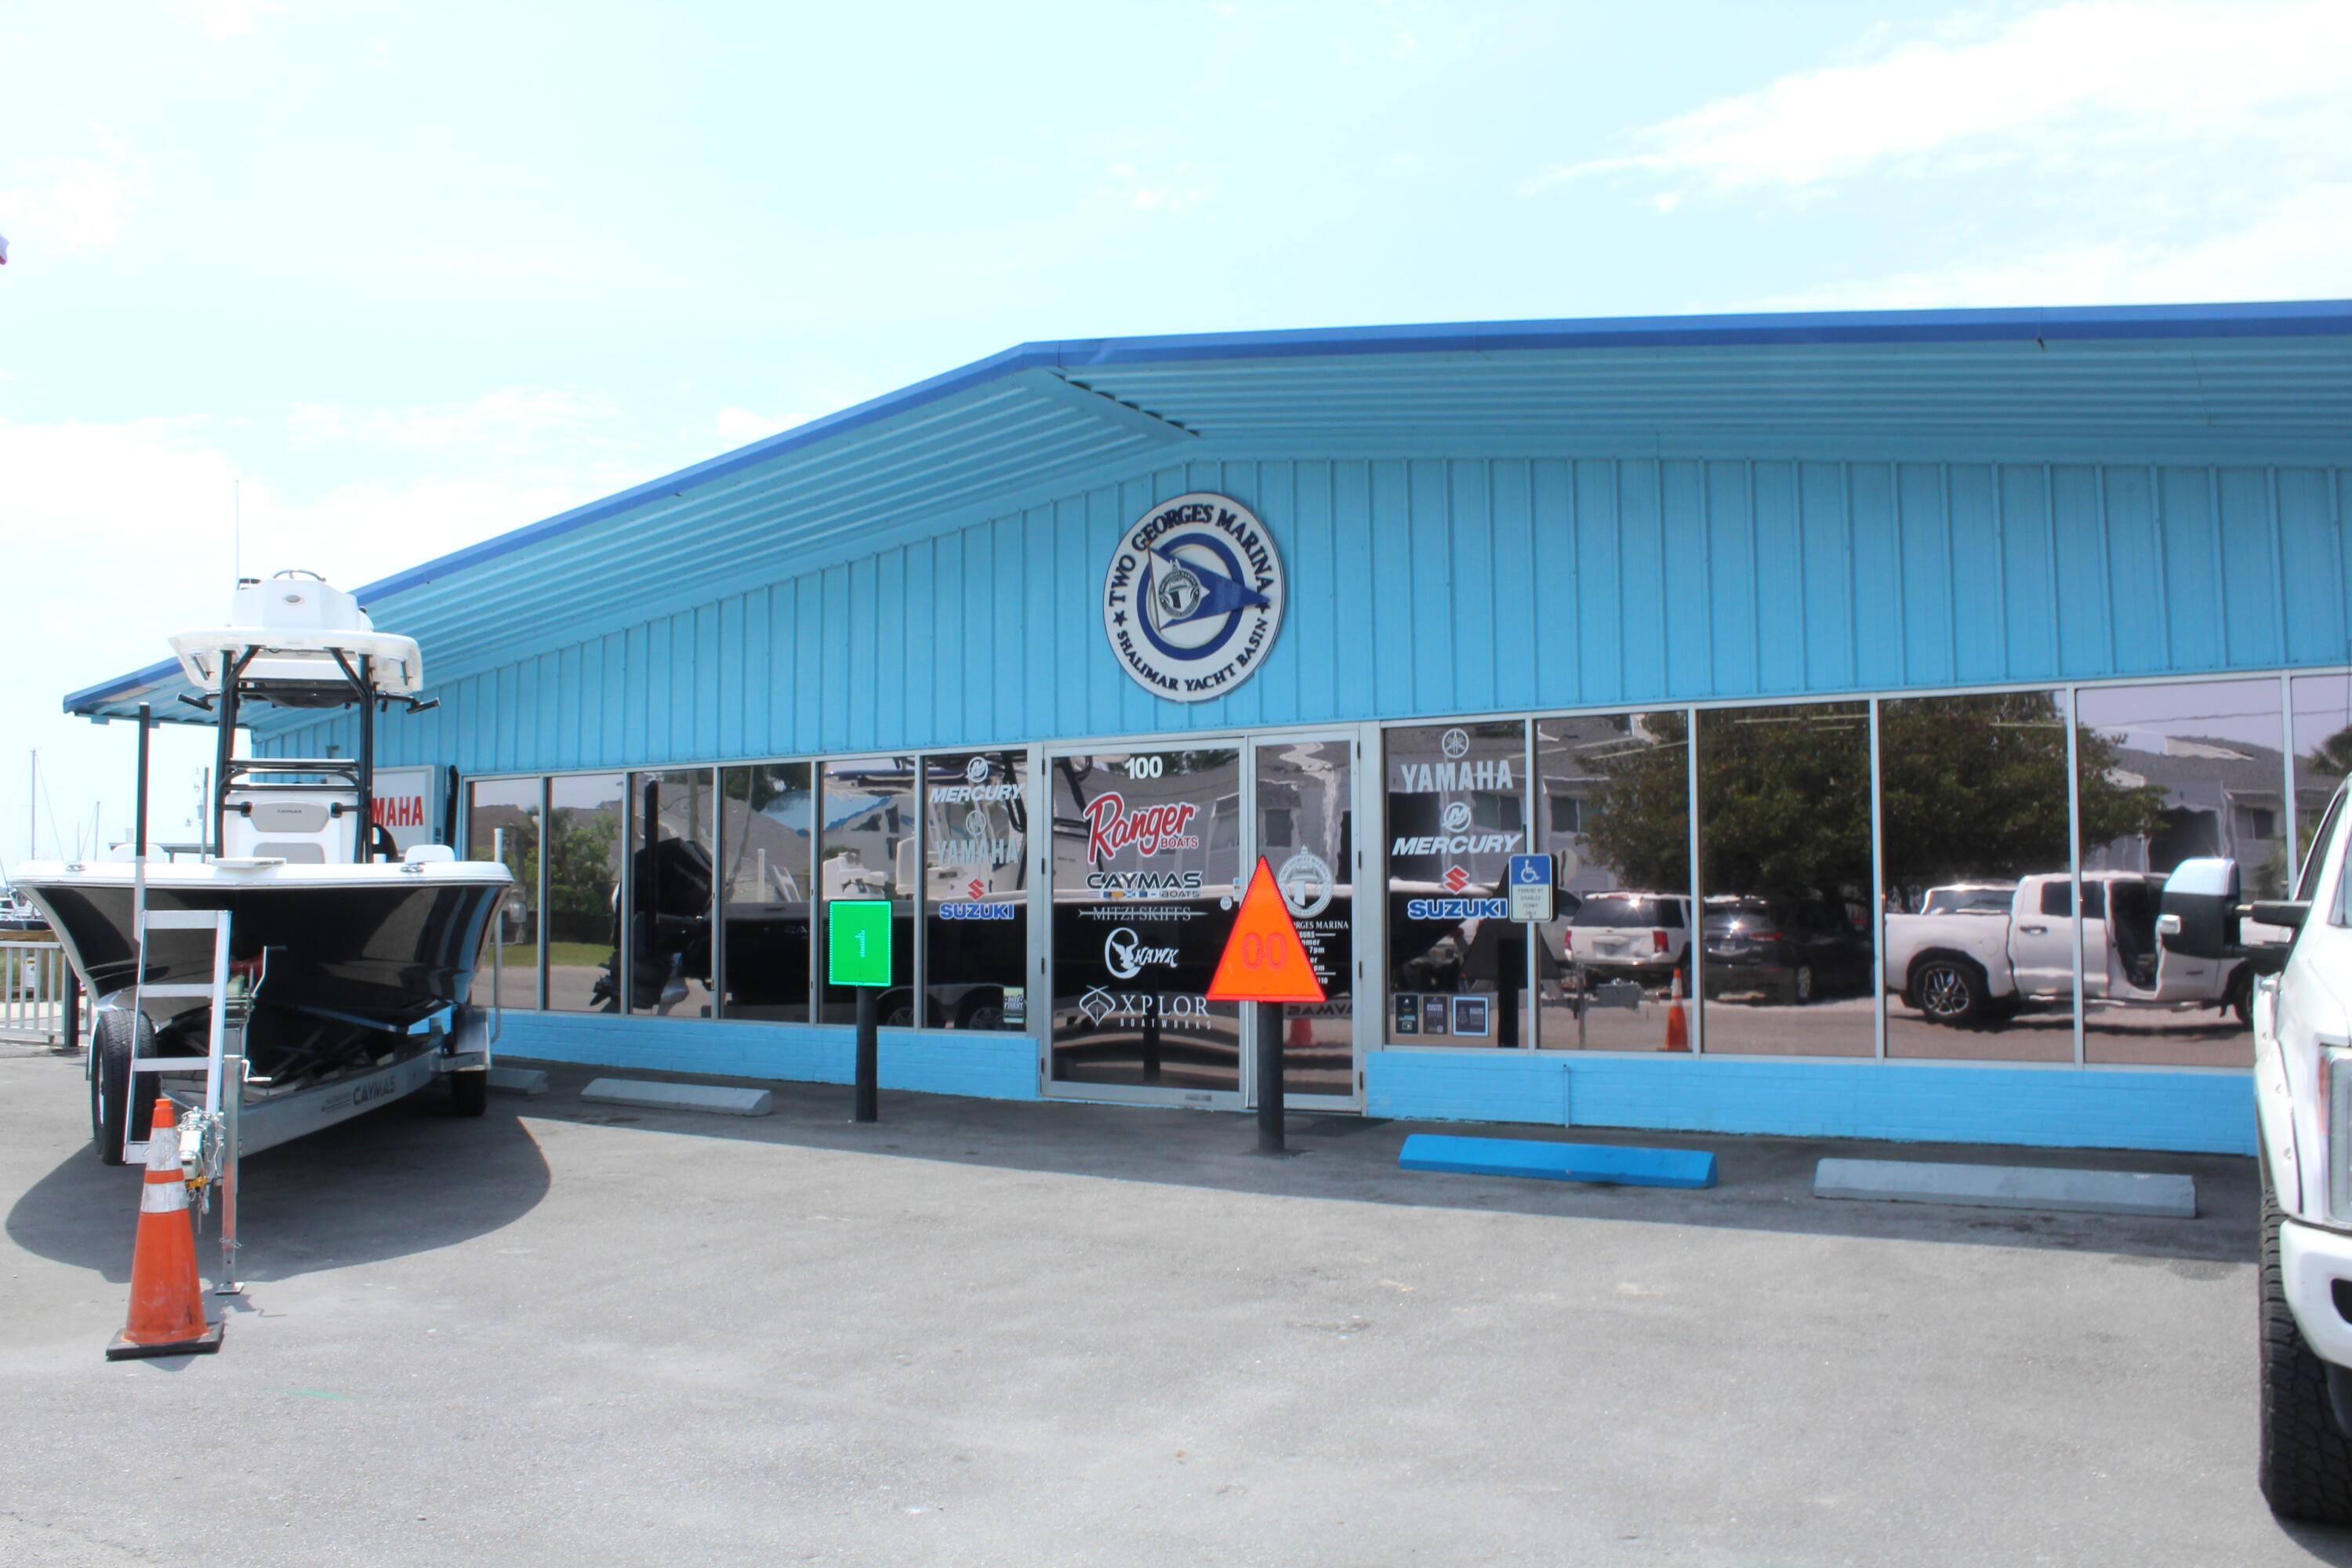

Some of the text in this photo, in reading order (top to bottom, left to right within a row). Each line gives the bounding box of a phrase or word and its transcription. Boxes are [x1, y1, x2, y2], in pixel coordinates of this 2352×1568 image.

[1109, 554, 1136, 607] TWO
[1131, 504, 1214, 552] GEORGES
[1215, 509, 1274, 593] MARINA
[1116, 617, 1268, 692] SHALIMAR YACHT BASIN
[1124, 757, 1163, 780] 100
[1400, 760, 1514, 793] YAMAHA
[929, 783, 1025, 804] MERCURY
[371, 796, 424, 827] MAHA
[1083, 792, 1196, 866] Ranger
[935, 839, 1019, 866] YAMAHA
[1160, 837, 1200, 849] BOATS
[1392, 833, 1524, 856] MERCURY
[1086, 871, 1203, 890] CAYMAS
[939, 902, 1014, 920] SUZUKI
[1093, 906, 1192, 921] MITZI SKIFFS
[1407, 898, 1508, 920] SUZUKI
[1294, 920, 1349, 929] RGES MARINA
[1298, 931, 1315, 939] OURS
[855, 929, 866, 958] 1
[1120, 994, 1210, 1018] XPLOR
[1120, 1018, 1212, 1030] BOATWORKS
[353, 1075, 396, 1105] CAYMAS
